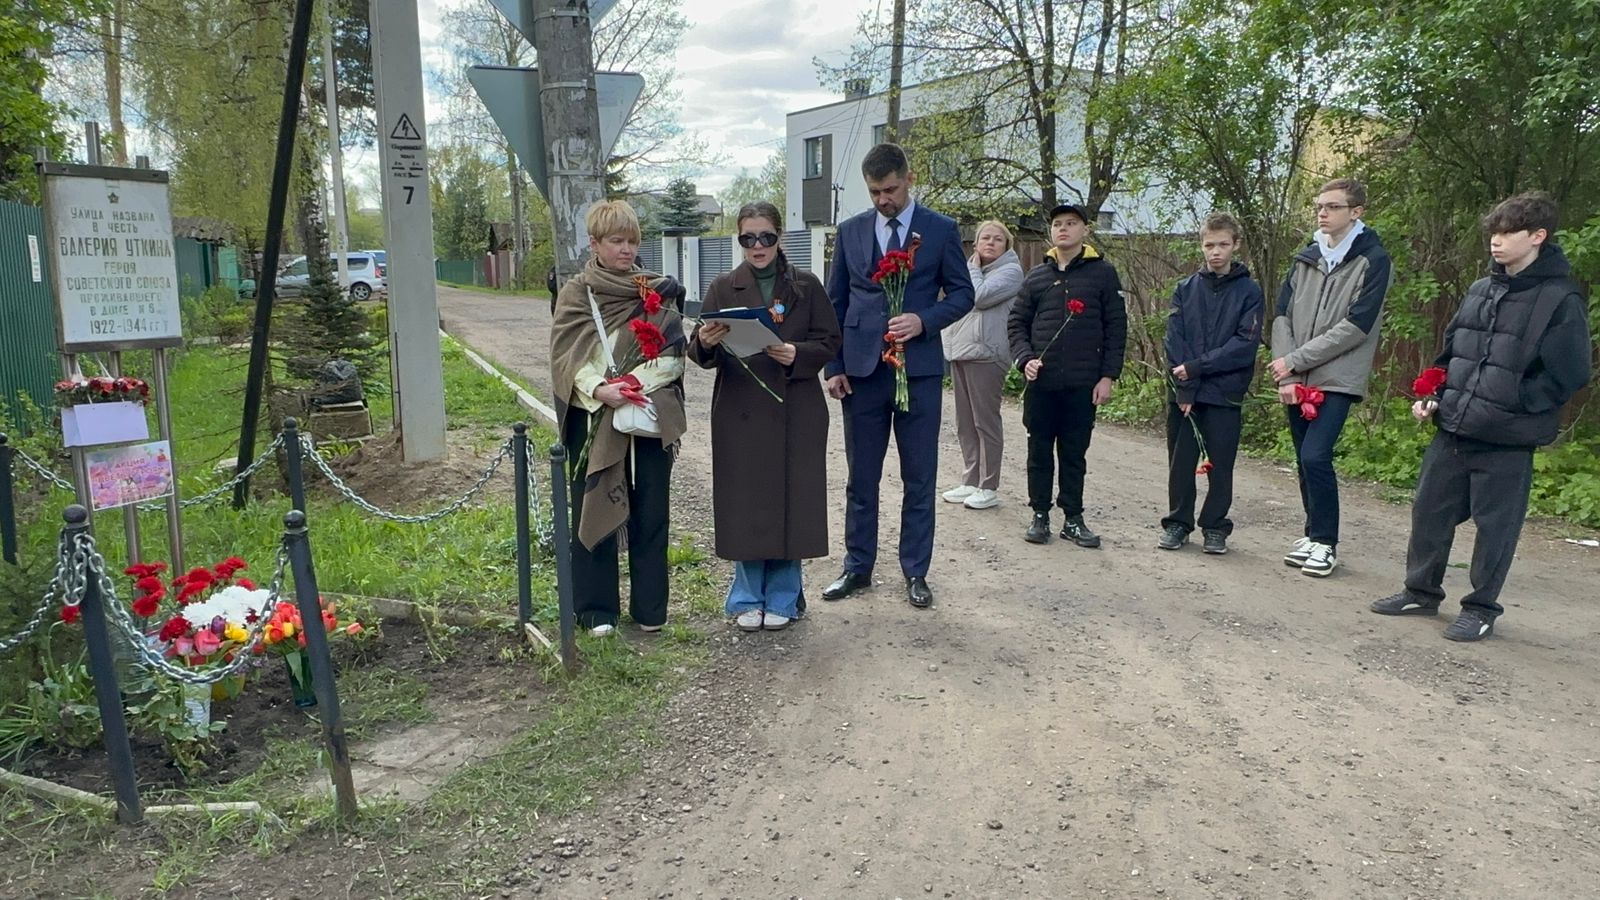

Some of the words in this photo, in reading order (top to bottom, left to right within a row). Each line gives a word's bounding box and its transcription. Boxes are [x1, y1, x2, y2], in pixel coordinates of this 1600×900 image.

[403, 186, 414, 205] 7
[70, 207, 104, 220] УЛИЦА
[112, 211, 155, 222] НАЗВАНА
[92, 222, 98, 233] В
[108, 222, 138, 233] ЧЕСТЬ
[60, 236, 118, 257] ВАЛЕРИЯ
[125, 238, 172, 257] УТКИНА
[104, 261, 137, 275] ГЕРОЯ
[66, 277, 132, 291] СОВЕТСКОГО
[136, 277, 172, 289] СОЮЗА
[90, 305, 97, 316] В
